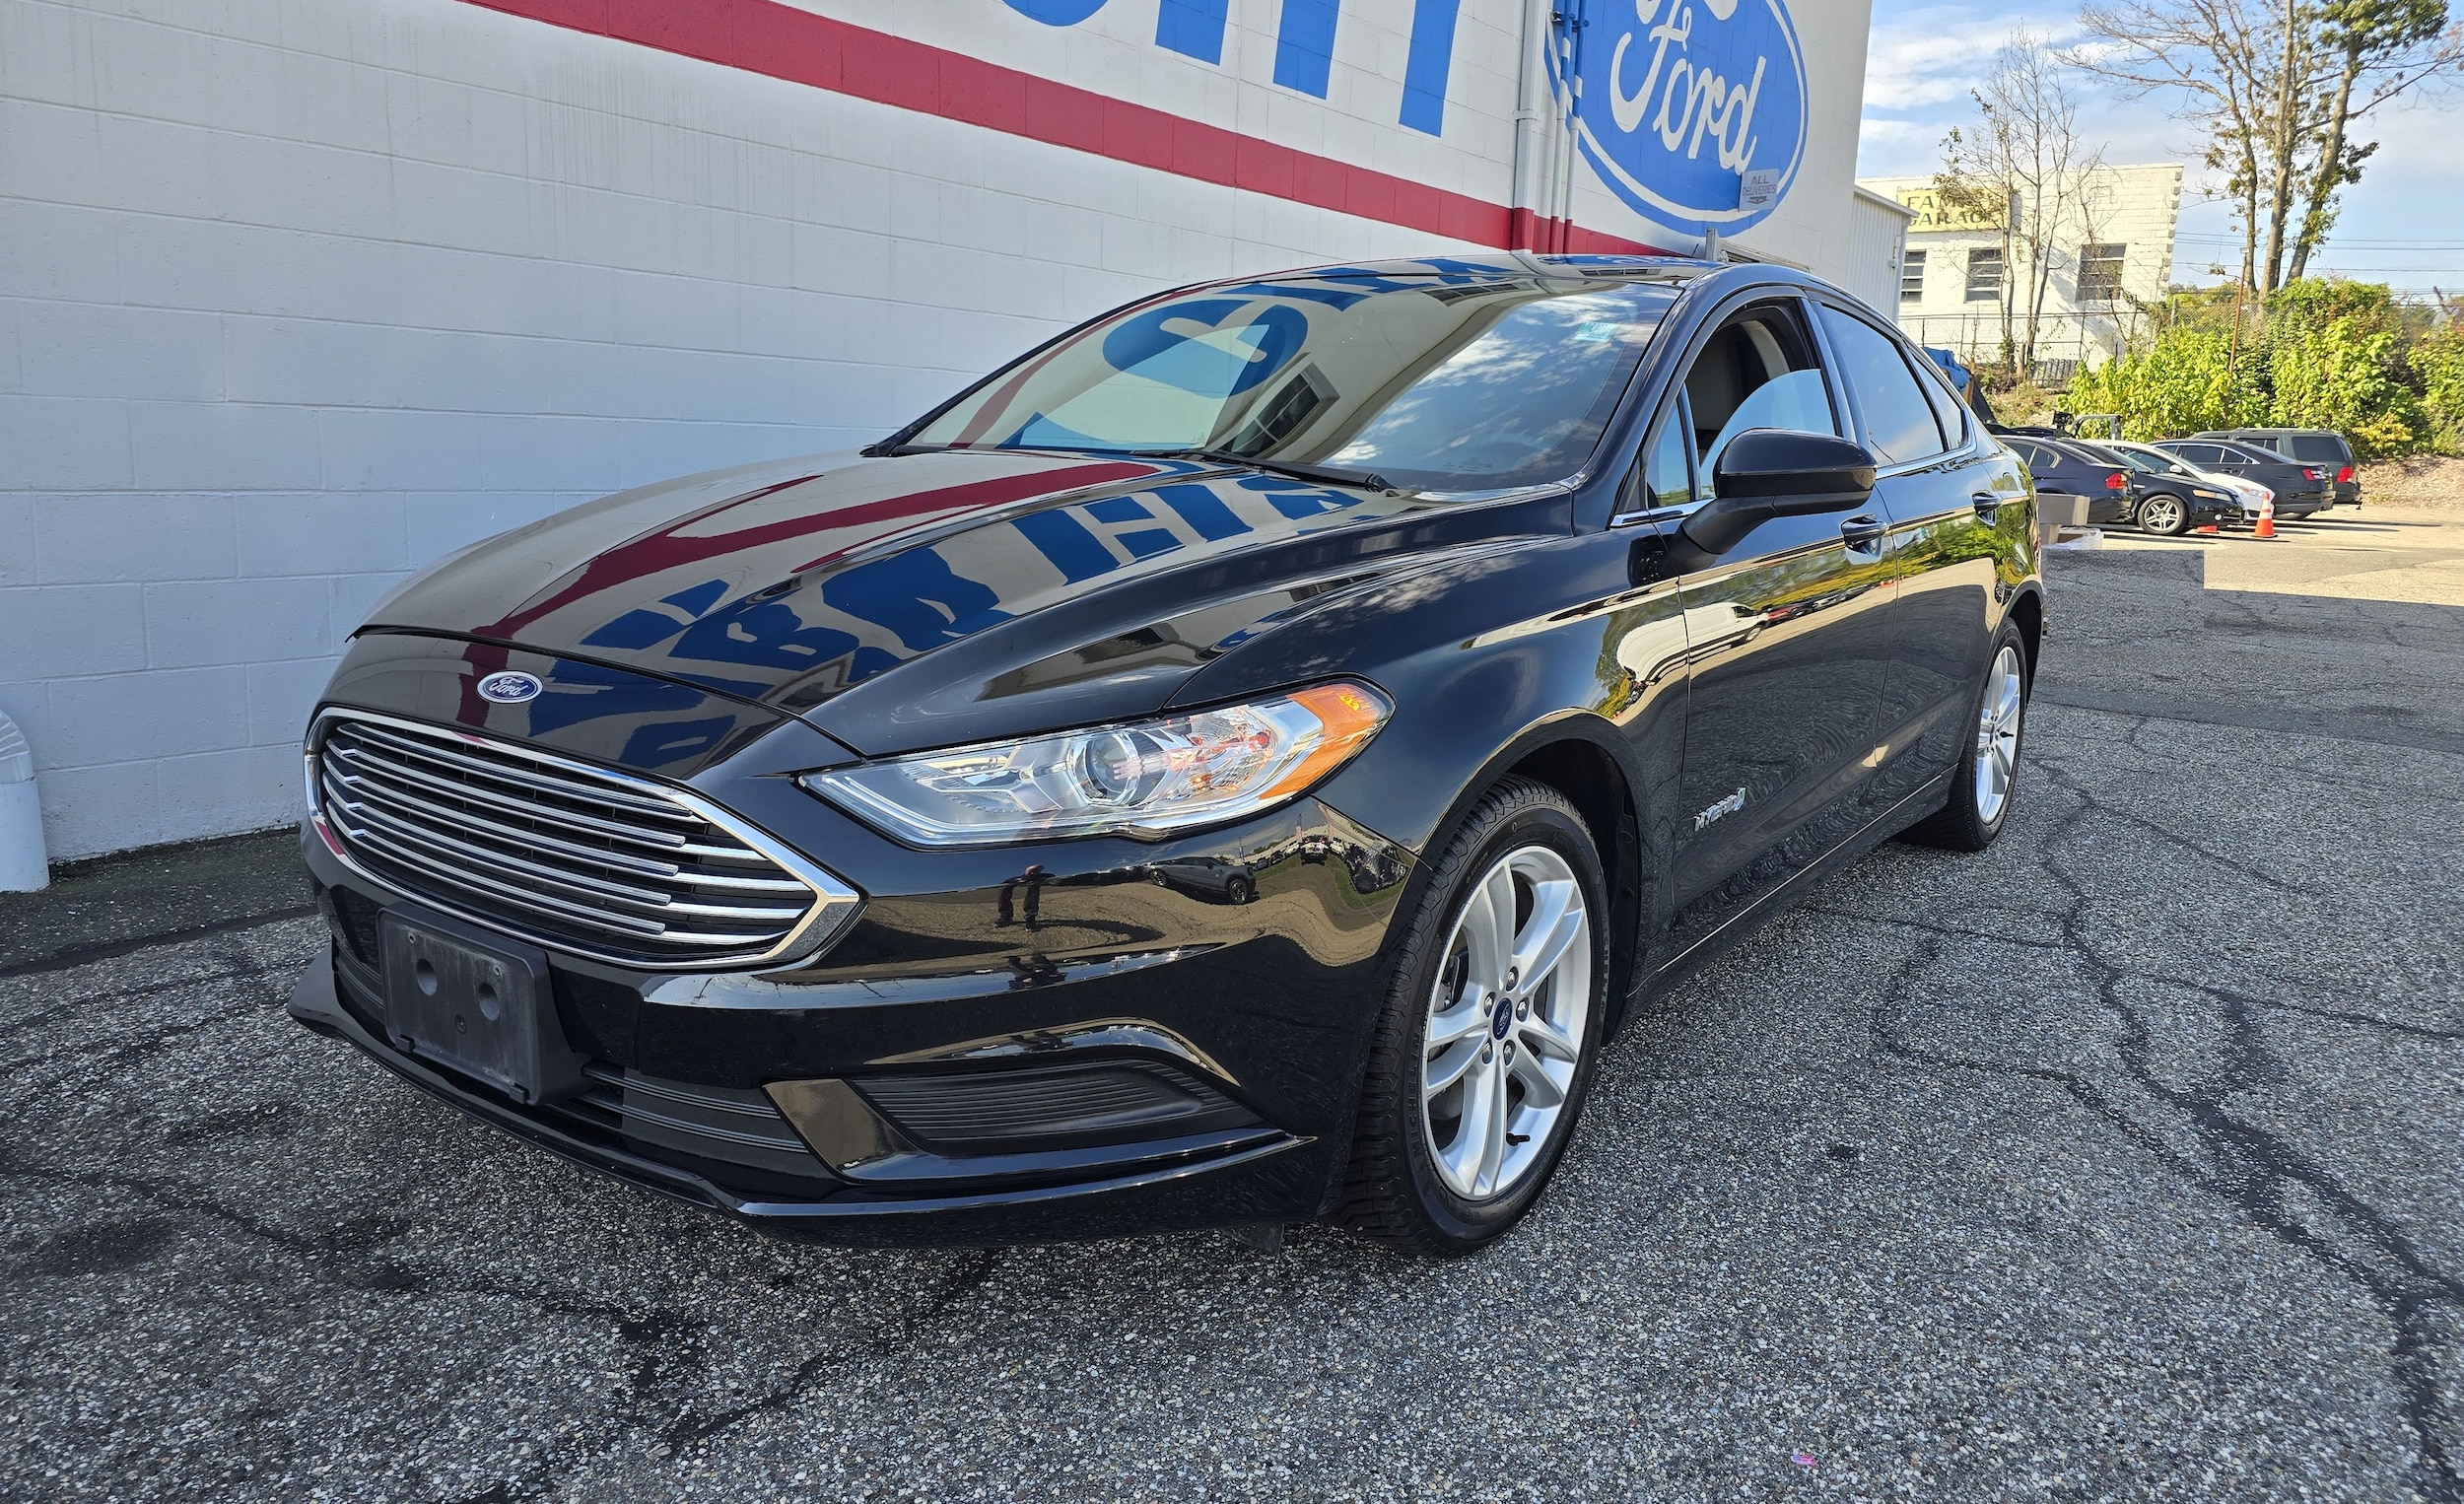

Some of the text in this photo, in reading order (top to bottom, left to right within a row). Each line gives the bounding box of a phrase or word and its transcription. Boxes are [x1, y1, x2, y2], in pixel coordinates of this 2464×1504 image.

[1610, 0, 1767, 176] Ford
[1742, 184, 1778, 197] DELIVERIES
[1750, 174, 1770, 185] ALL
[488, 675, 529, 698] Ford
[1406, 1032, 1421, 1158] MICHELIN
